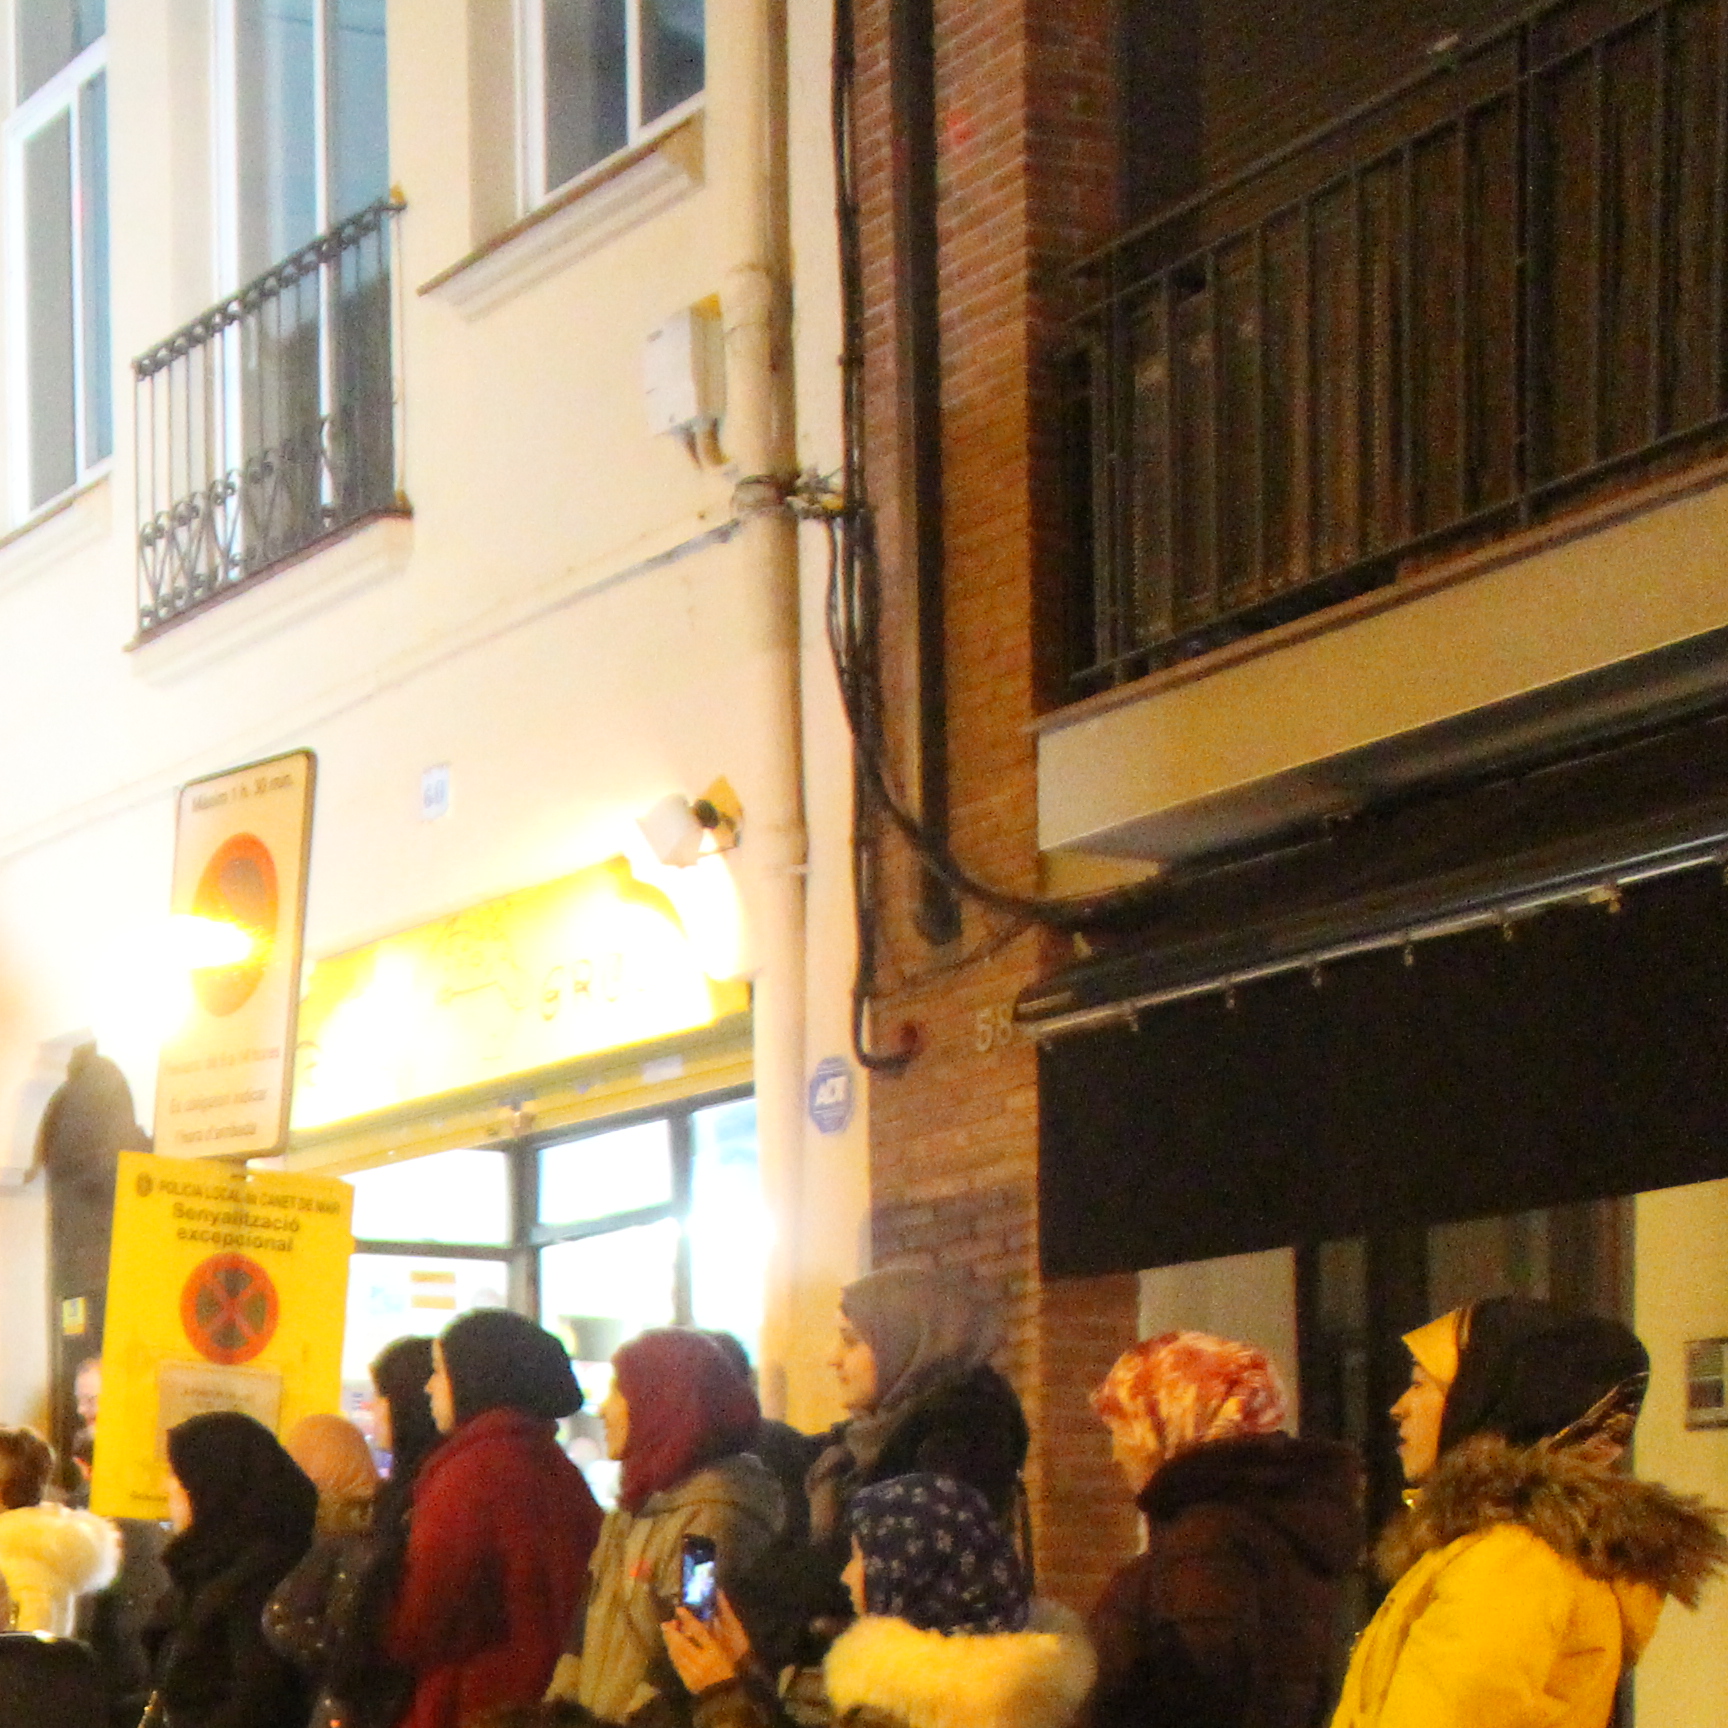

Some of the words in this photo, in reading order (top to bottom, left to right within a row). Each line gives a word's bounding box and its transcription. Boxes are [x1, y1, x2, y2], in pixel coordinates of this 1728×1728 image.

[976, 1004, 1012, 1052] 58
[815, 1075, 848, 1107] ADT
[159, 1179, 202, 1197] POLICIA
[206, 1185, 240, 1203] LOCAL
[173, 1202, 300, 1232] Senyalització
[177, 1227, 294, 1251] excepcional
